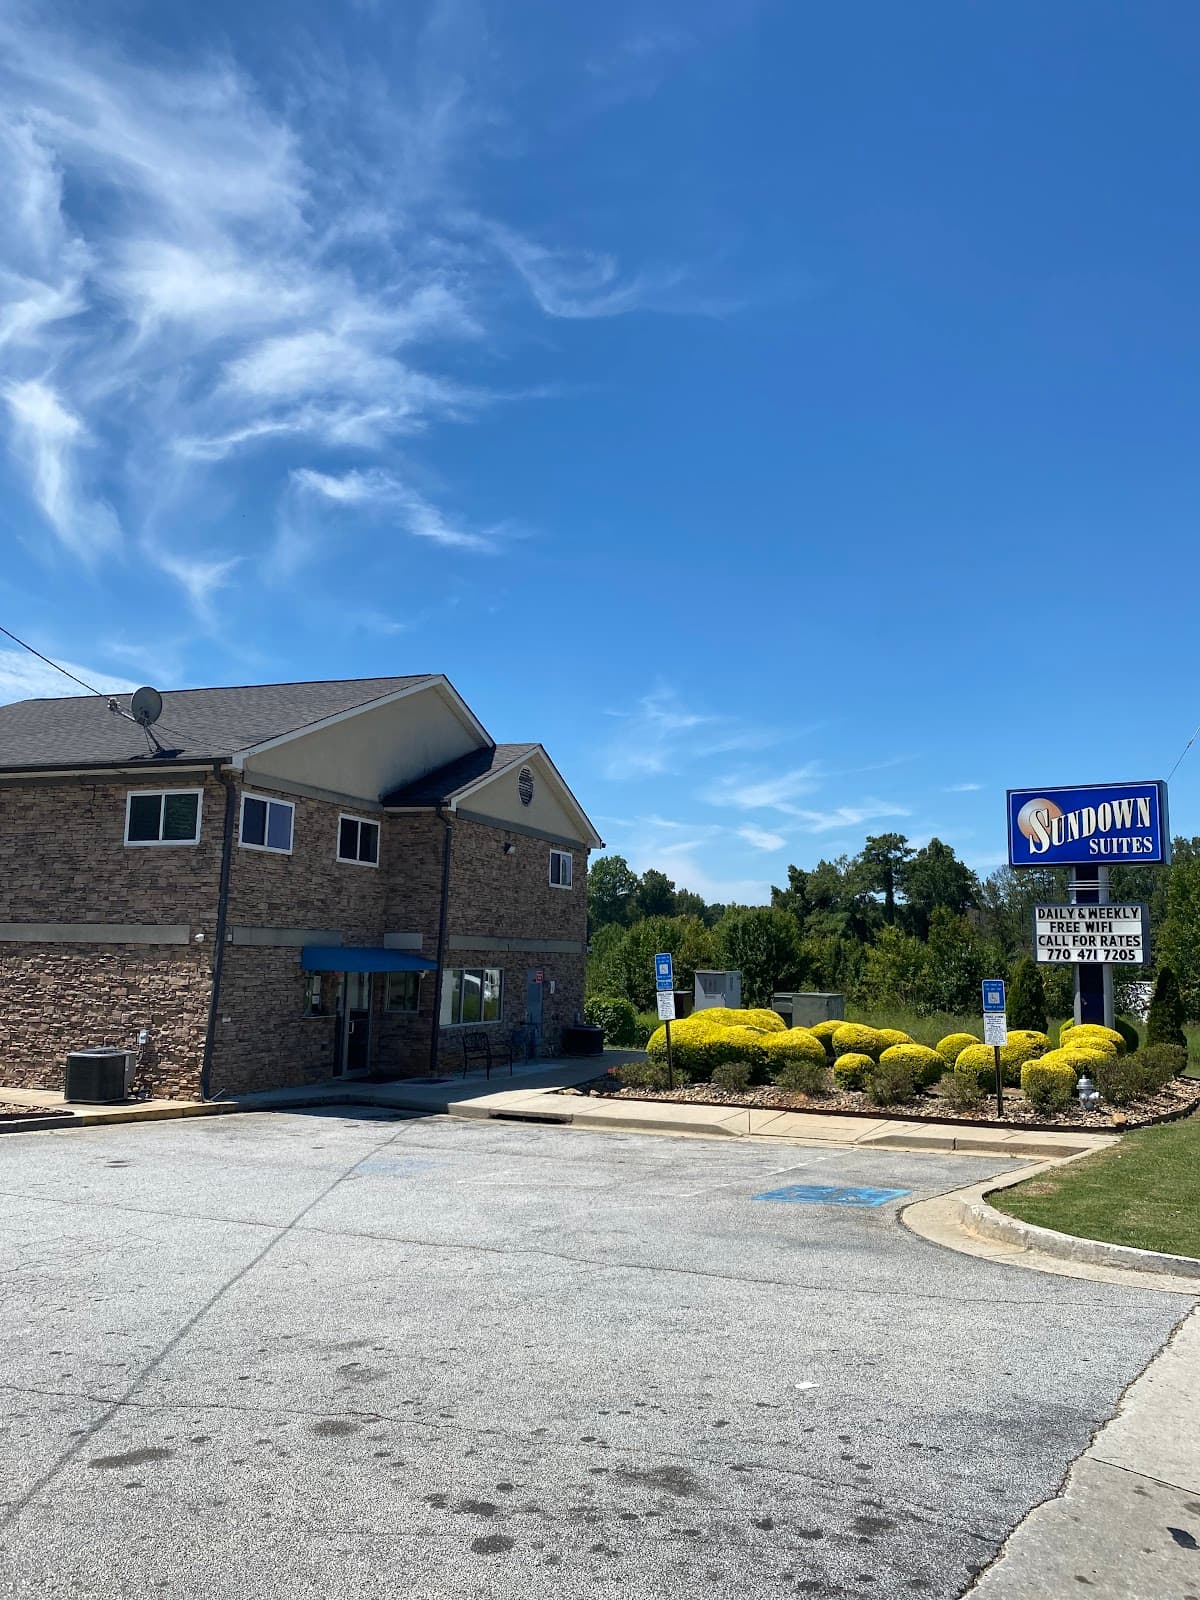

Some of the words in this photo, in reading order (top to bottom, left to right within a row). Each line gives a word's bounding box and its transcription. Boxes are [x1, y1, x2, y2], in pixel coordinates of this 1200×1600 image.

[1029, 797, 1151, 854] SUNDOWN
[1089, 836, 1153, 855] SUITES
[1038, 908, 1074, 919] DAILY
[1078, 908, 1086, 919] &
[1088, 907, 1138, 919] WEEKLY
[1049, 921, 1080, 933] FREE
[1085, 921, 1113, 933] WIFI
[1038, 935, 1069, 946] CALL
[1072, 935, 1097, 946] FOR
[1100, 935, 1140, 947] RATES
[1047, 949, 1071, 960] 770
[1077, 949, 1097, 960] 471
[1104, 949, 1136, 960] 7205
